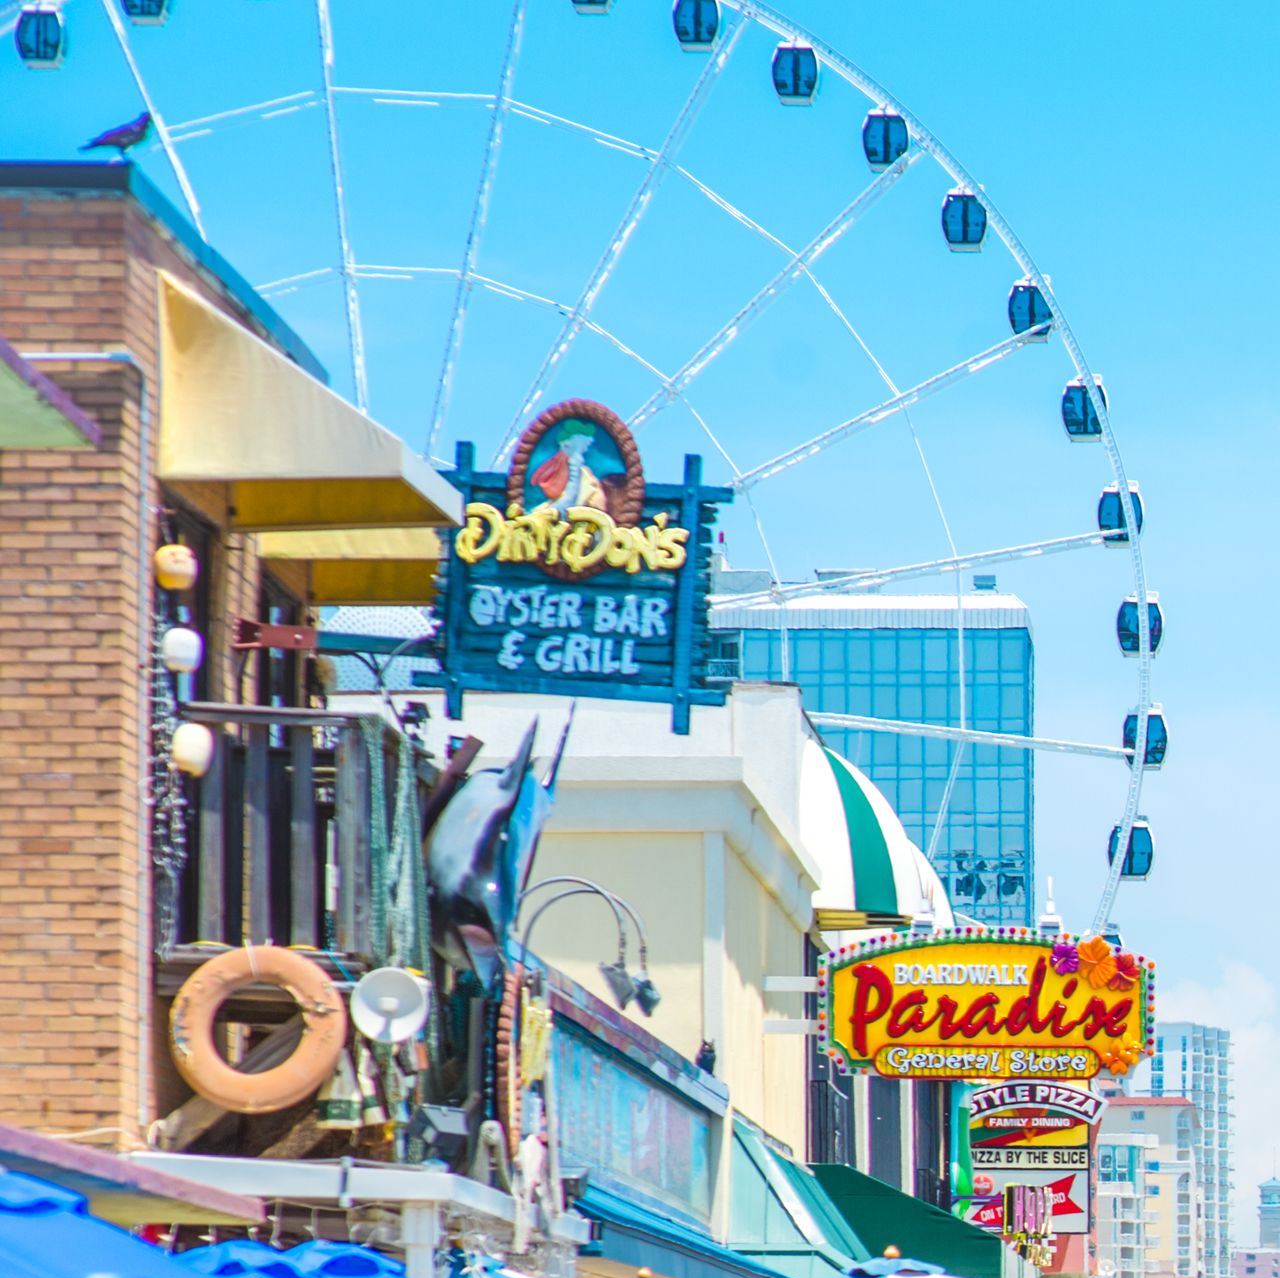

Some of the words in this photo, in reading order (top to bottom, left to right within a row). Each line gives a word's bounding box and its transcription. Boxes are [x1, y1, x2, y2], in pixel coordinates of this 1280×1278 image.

[469, 584, 582, 629] OYSTER
[593, 594, 669, 638] BAR
[497, 630, 526, 670] &
[535, 633, 640, 675] GRILL
[894, 963, 1029, 986] BOARDWALK
[849, 955, 1133, 1058] Paradise
[887, 1046, 1000, 1073] General
[1009, 1048, 1087, 1074] Store
[1035, 1085, 1097, 1116] PIZZA
[988, 1117, 1030, 1127] FAMILY
[1031, 1117, 1071, 1128] DINING
[1006, 1151, 1022, 1164] BY
[1027, 1151, 1048, 1164] THE
[1053, 1151, 1086, 1165] SLICE
